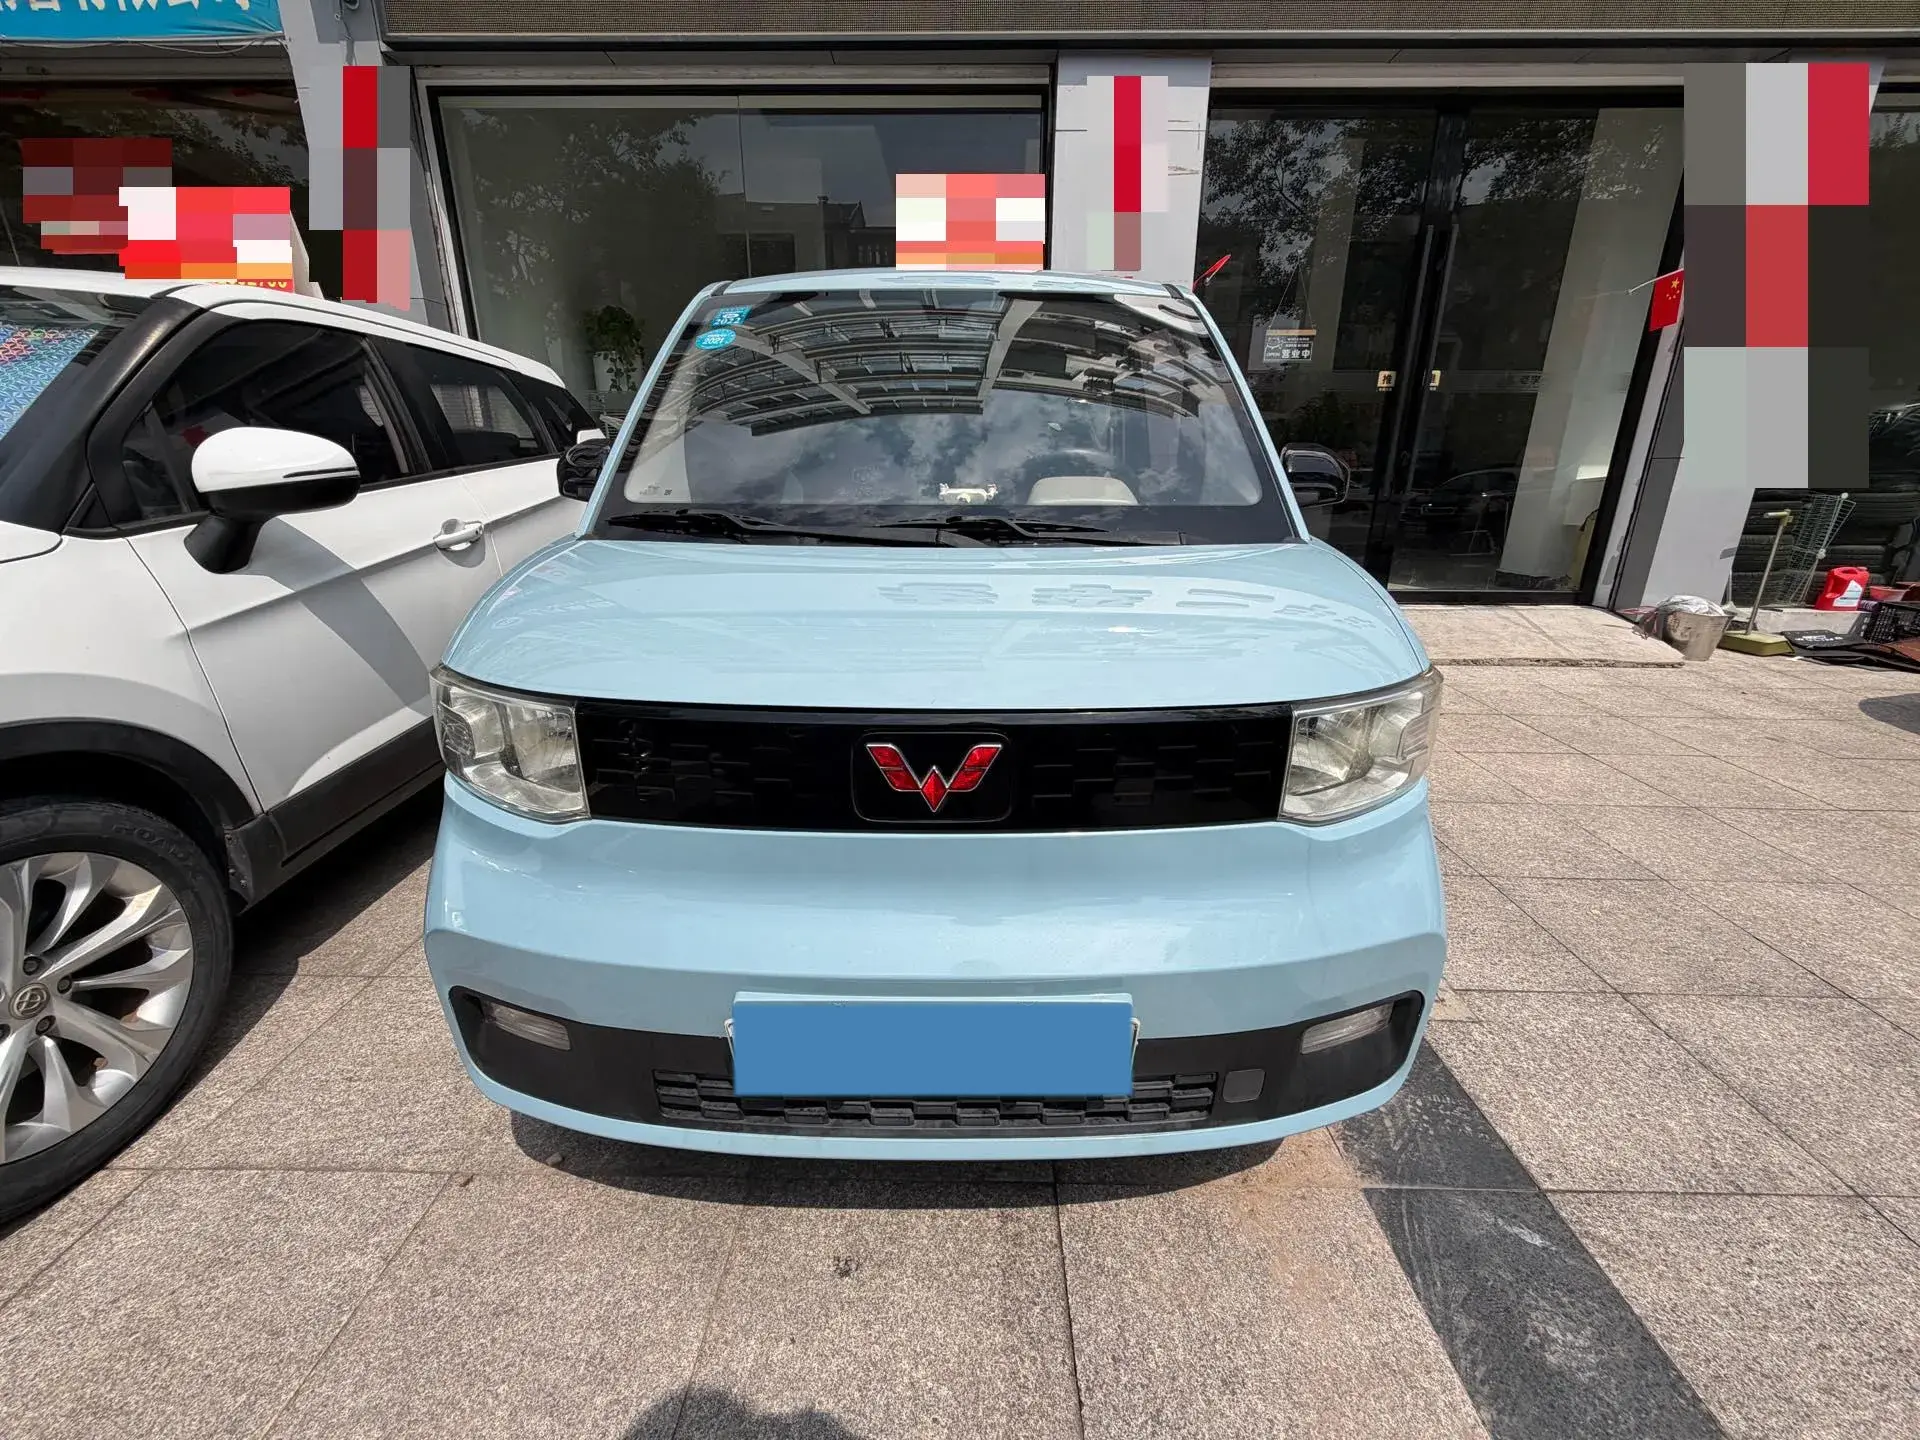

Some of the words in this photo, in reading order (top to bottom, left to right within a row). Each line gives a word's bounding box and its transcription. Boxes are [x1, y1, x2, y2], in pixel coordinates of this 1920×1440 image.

[713, 317, 741, 326] 2022
[702, 337, 725, 345] 2021
[1281, 349, 1311, 359] 营业中
[1382, 374, 1393, 385] 推
